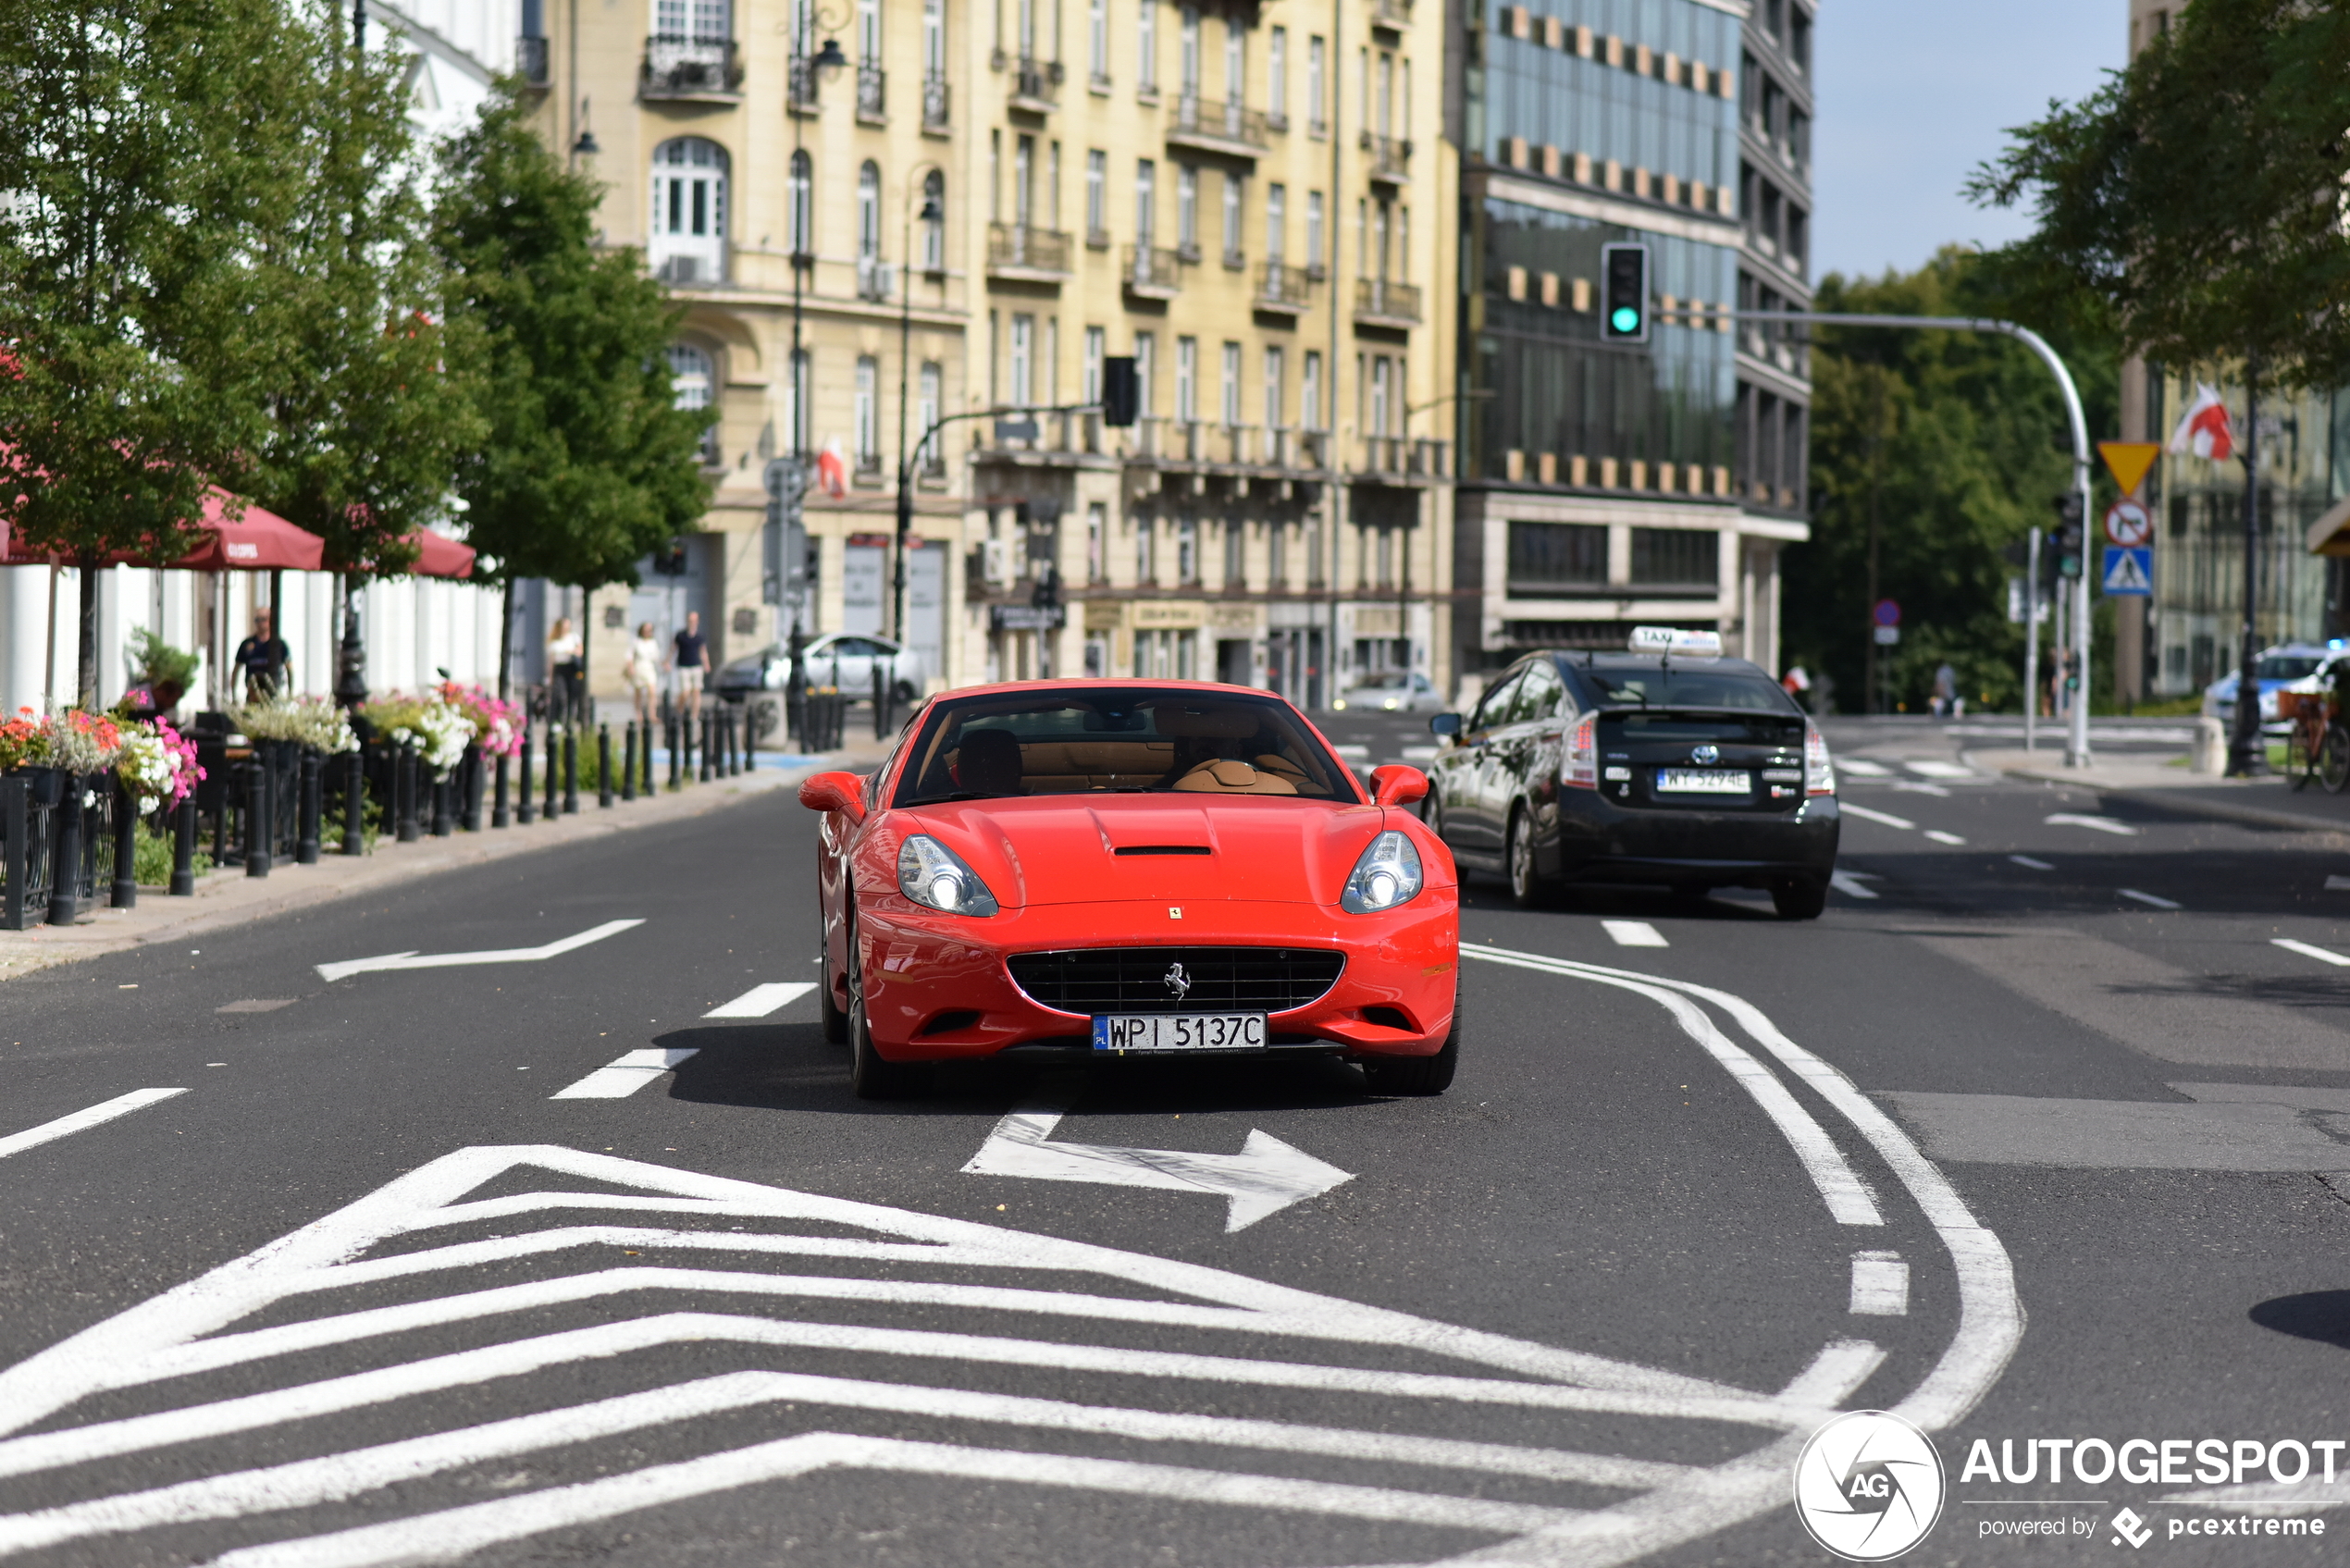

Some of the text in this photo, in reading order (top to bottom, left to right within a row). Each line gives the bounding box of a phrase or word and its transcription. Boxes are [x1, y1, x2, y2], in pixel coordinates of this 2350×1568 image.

[1641, 630, 1673, 643] TAXI
[1667, 769, 1690, 785] WY
[1110, 1017, 1261, 1047] WPI 5137C
[1095, 1037, 1107, 1045] PL
